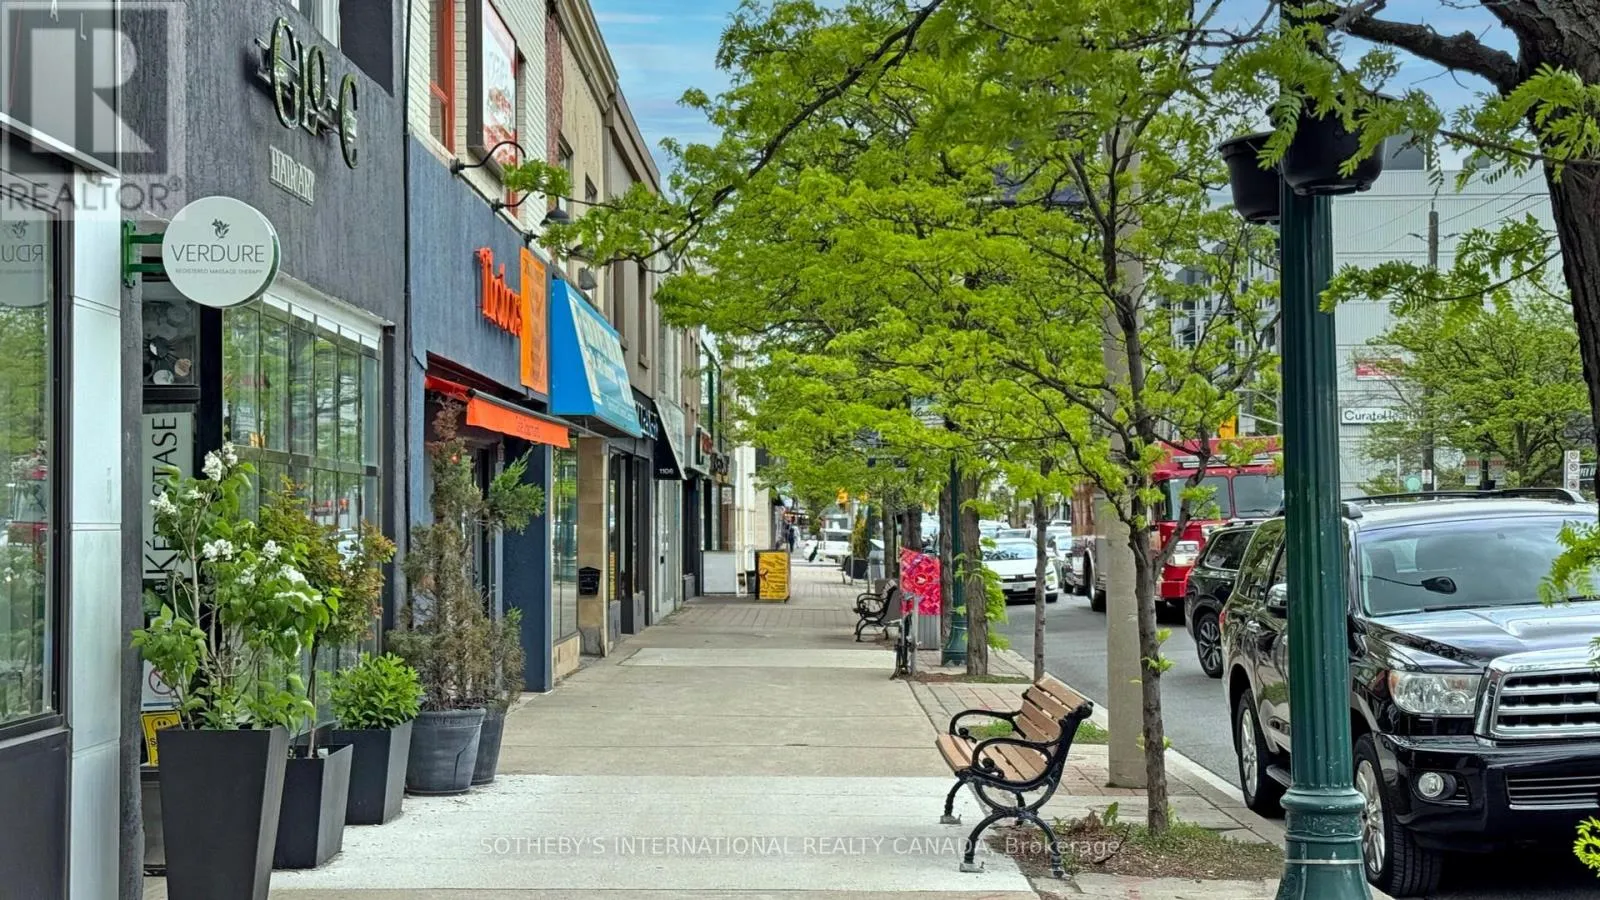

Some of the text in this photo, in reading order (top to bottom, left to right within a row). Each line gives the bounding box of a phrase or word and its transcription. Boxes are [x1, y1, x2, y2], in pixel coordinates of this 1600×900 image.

[269, 144, 316, 203] HAIR ART
[171, 244, 264, 262] VERDURE
[145, 417, 178, 574] KÉSTASE
